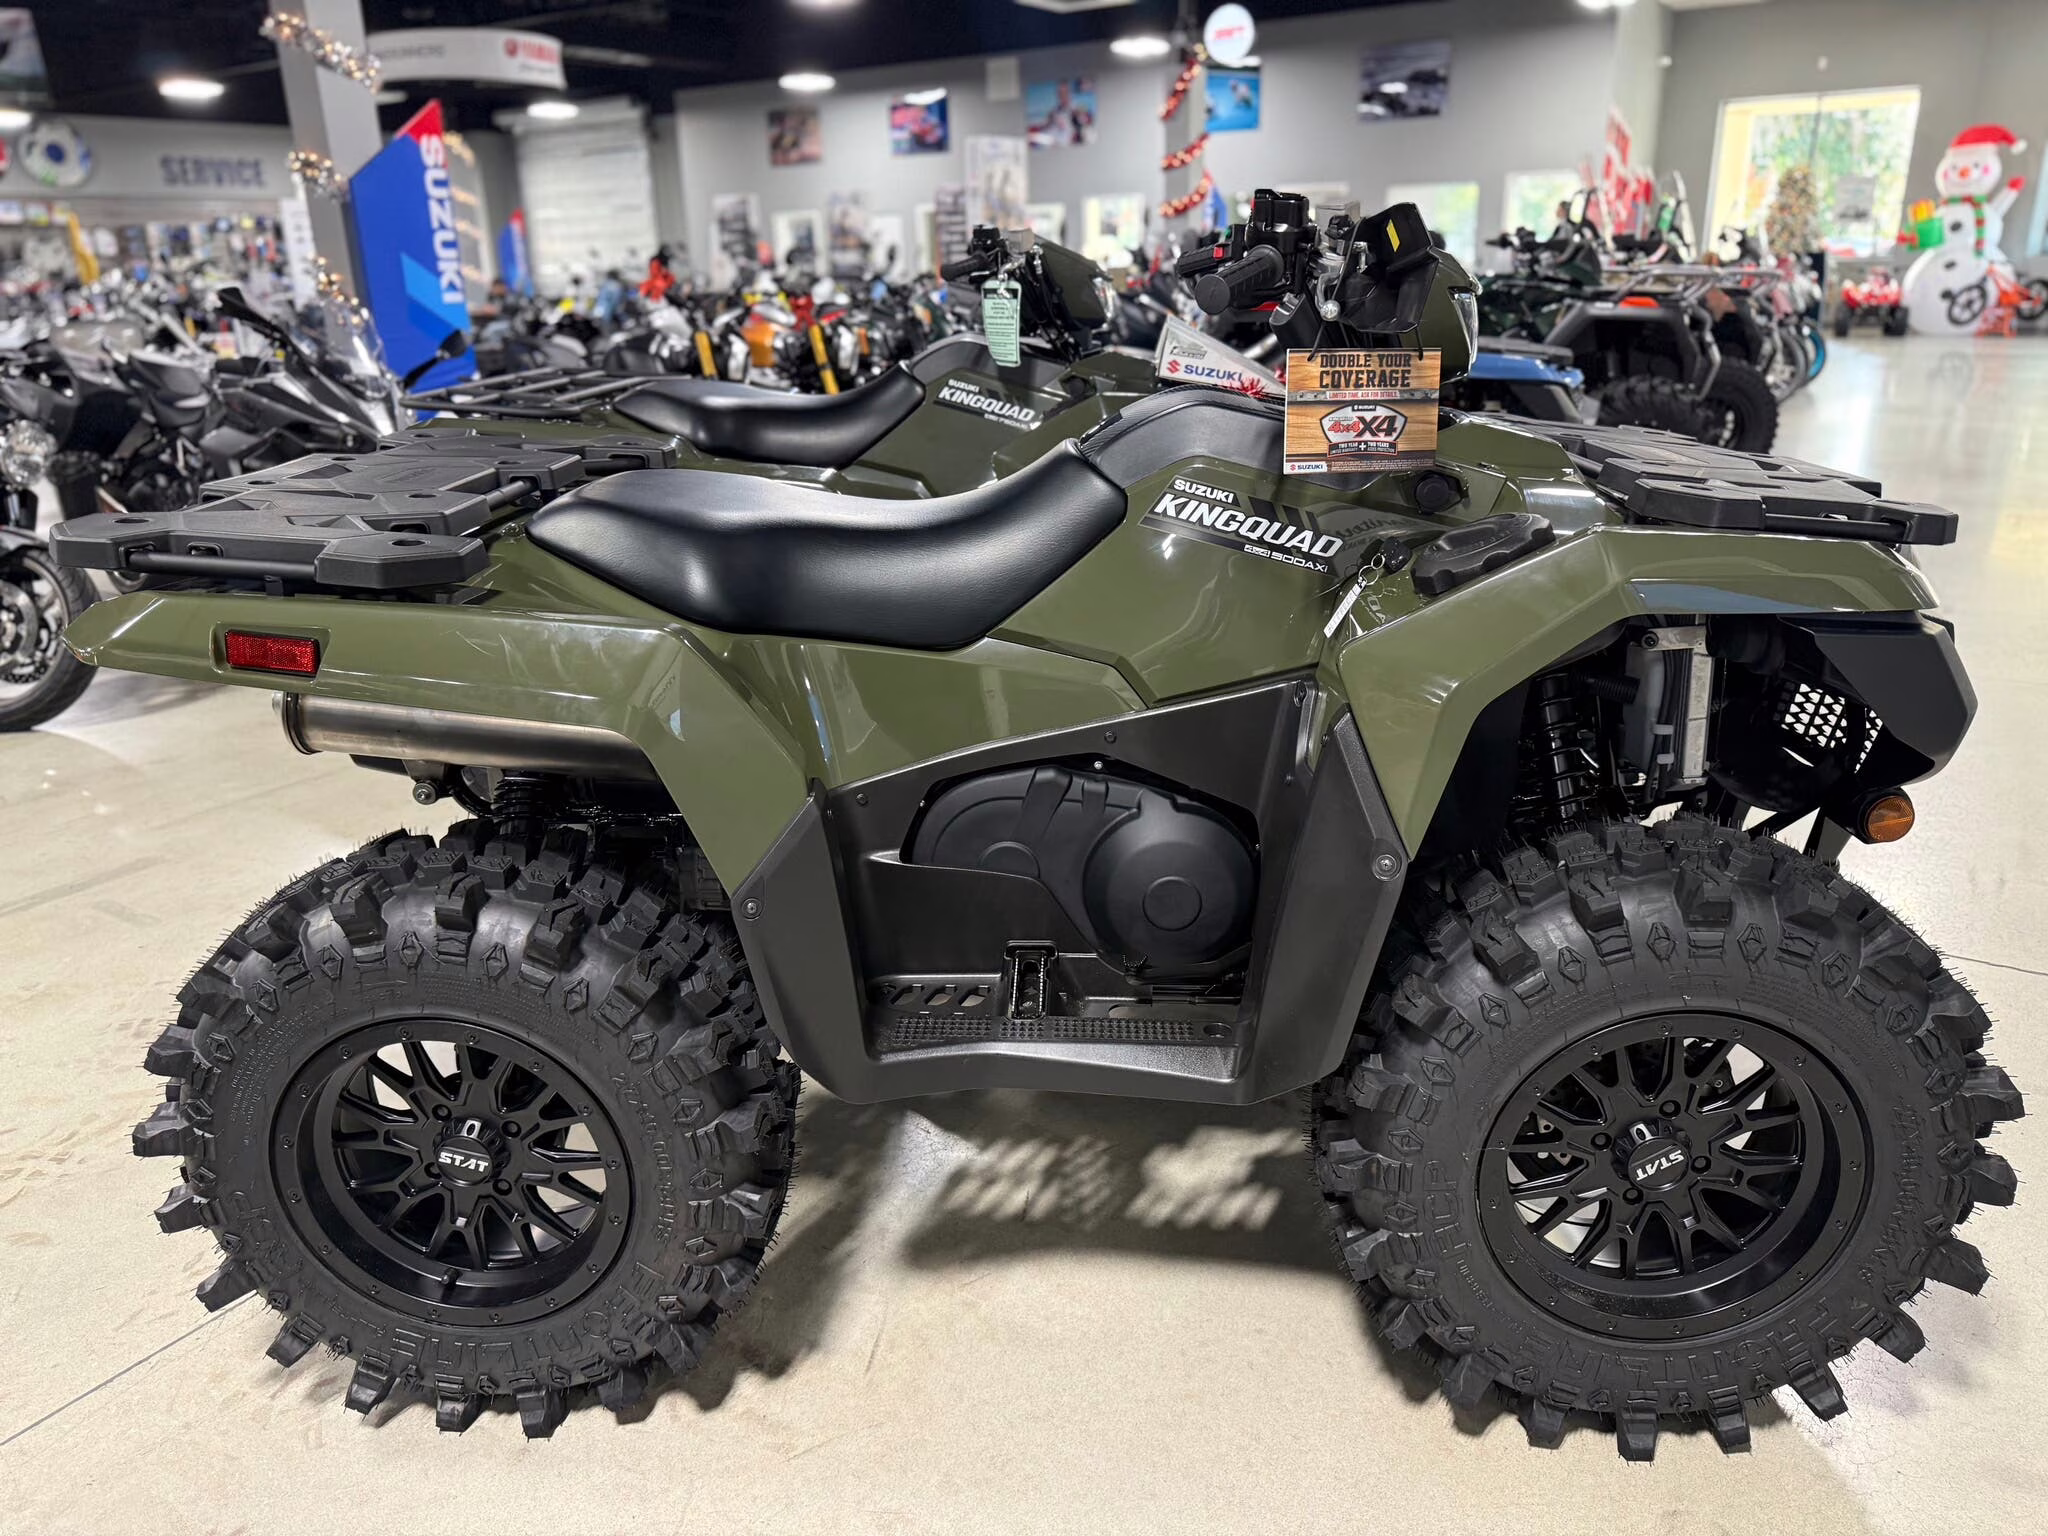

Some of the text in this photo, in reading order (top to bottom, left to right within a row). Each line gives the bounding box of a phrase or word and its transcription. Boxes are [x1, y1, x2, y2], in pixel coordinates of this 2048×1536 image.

[160, 154, 266, 187] SERVICE
[419, 133, 465, 305] SUZUKI
[1184, 364, 1243, 382] SUZUKI
[1320, 353, 1412, 368] DOUBLE YOUR
[948, 379, 980, 393] SUZUKI
[1320, 369, 1411, 388] COVERAGE
[938, 386, 1036, 421] KINGQUAD
[1173, 479, 1235, 504] SUZUKI
[1154, 493, 1344, 558] KINGQUAD
[437, 1151, 489, 1173] STAT
[1636, 1149, 1685, 1181] STAT
